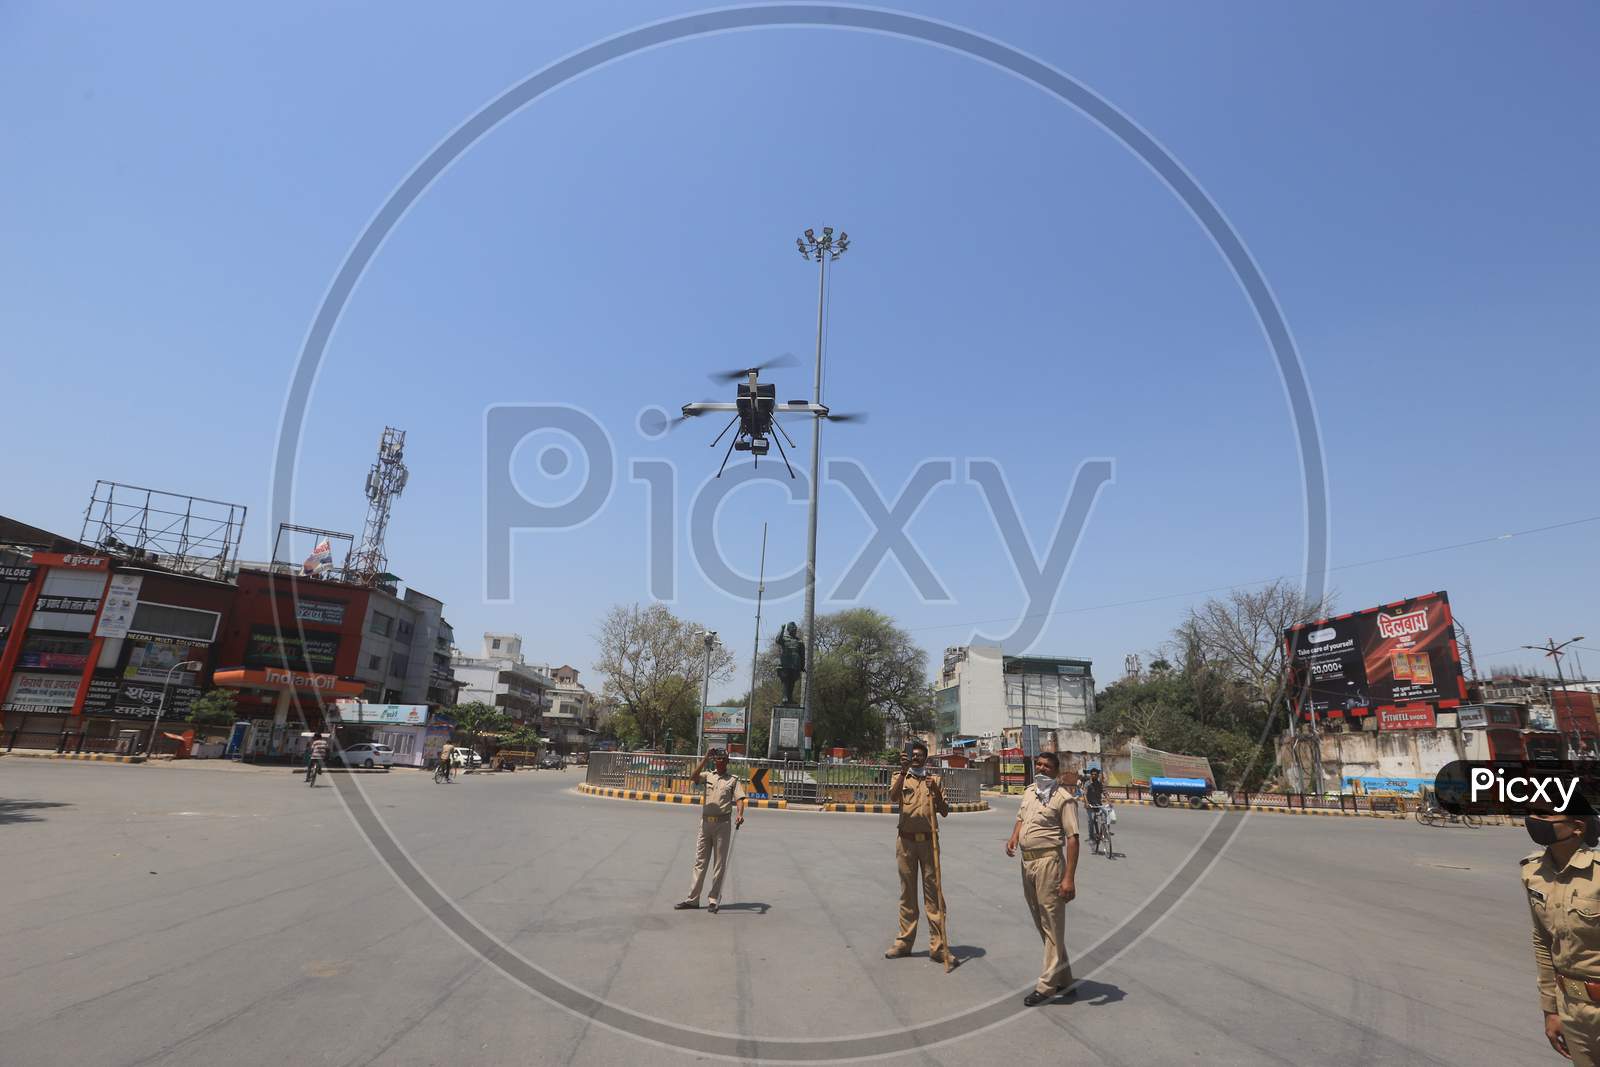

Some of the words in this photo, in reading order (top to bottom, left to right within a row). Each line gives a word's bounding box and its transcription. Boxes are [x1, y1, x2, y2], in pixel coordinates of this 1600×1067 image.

[0, 567, 31, 577] AILORS
[1330, 639, 1354, 652] yourself
[266, 671, 336, 688] IndianOil
